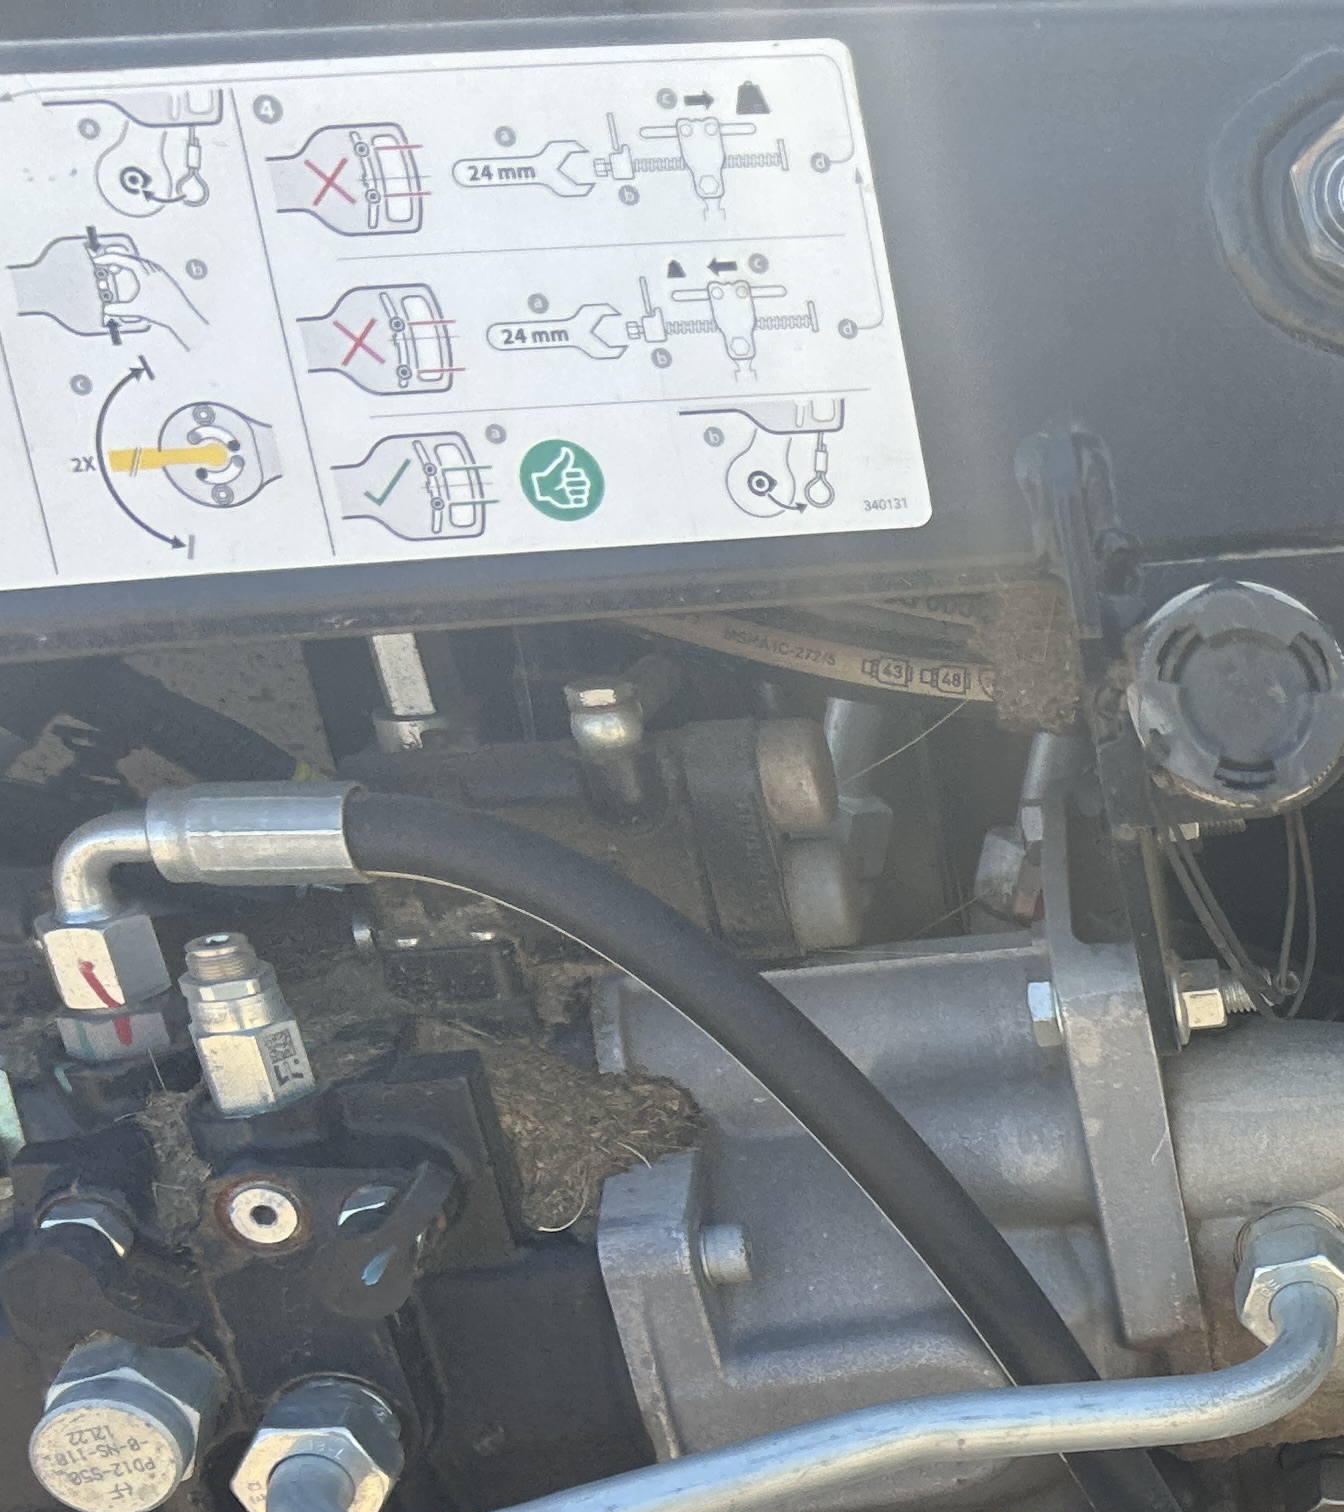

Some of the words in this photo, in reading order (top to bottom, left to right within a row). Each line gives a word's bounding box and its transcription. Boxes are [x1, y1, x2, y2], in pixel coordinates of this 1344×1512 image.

[468, 164, 493, 182] 24
[497, 165, 536, 181] mm
[501, 327, 527, 345] 24
[531, 328, 569, 343] mm
[70, 454, 97, 472] 2X
[863, 497, 909, 512] 340131
